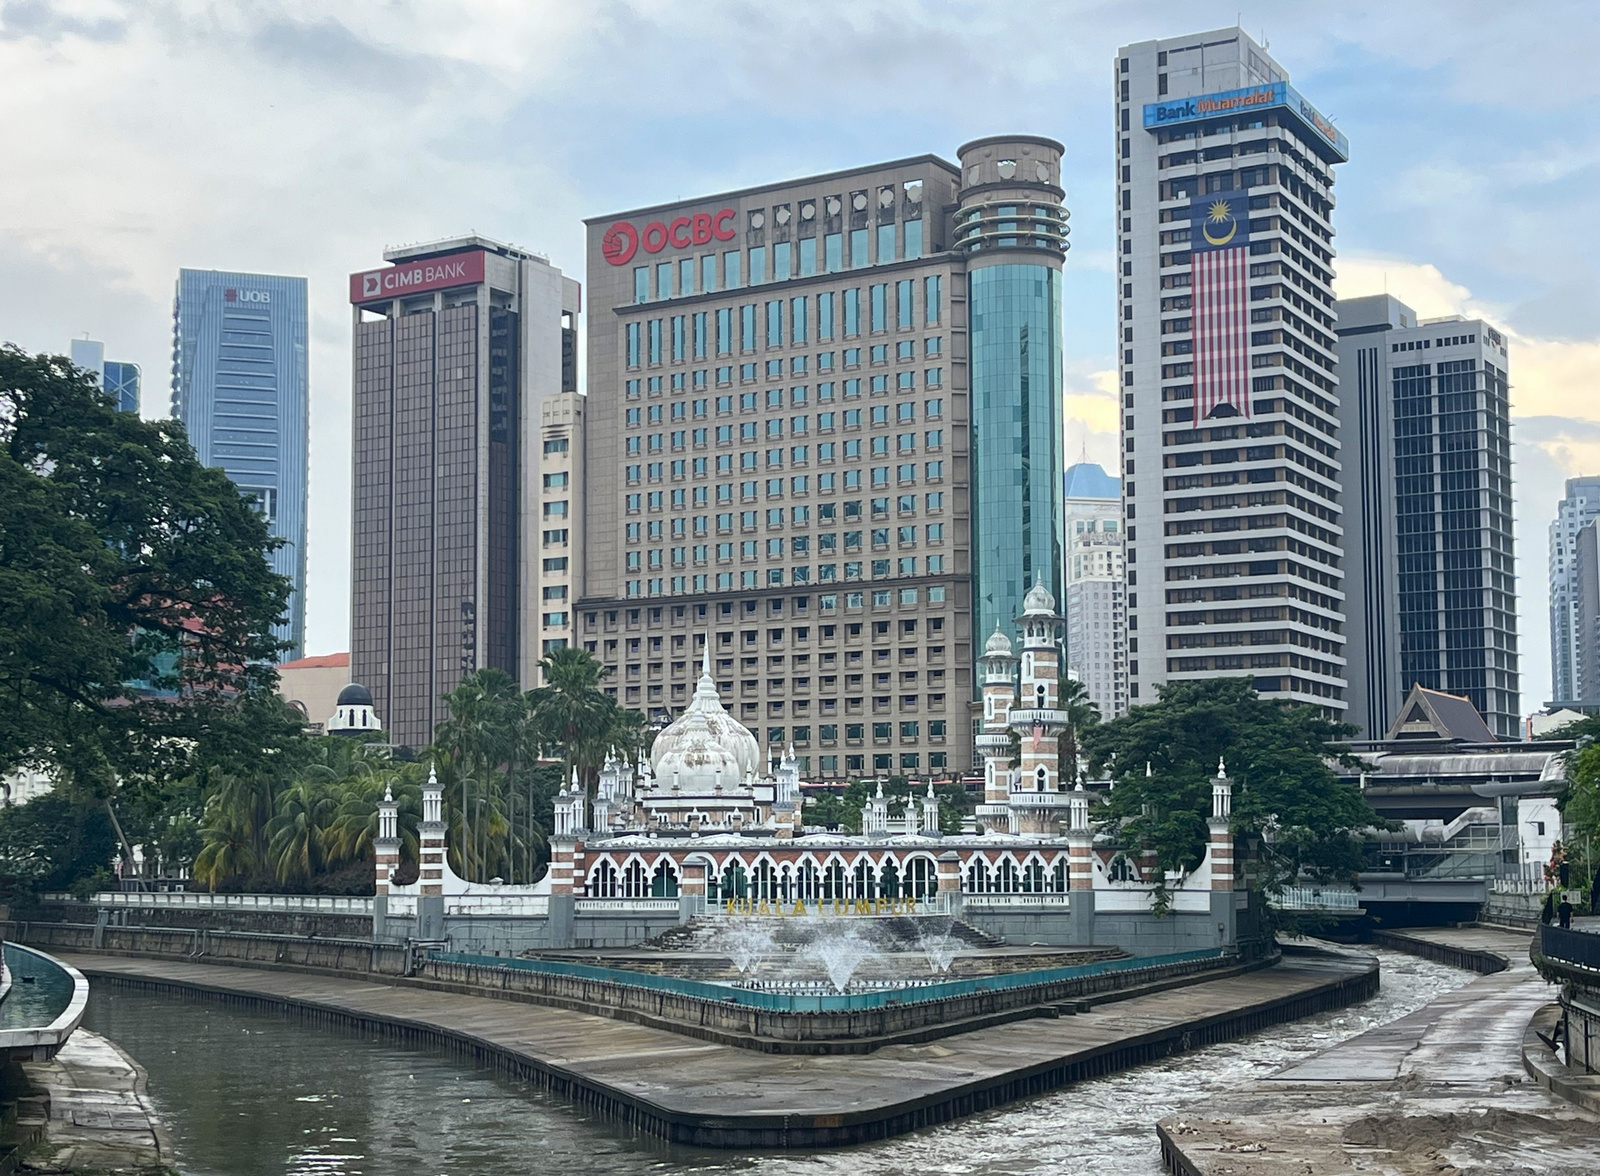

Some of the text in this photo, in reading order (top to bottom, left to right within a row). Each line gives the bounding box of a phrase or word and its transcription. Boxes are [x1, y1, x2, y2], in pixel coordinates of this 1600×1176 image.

[1156, 89, 1274, 122] Bank Muamalat
[641, 208, 737, 254] OCBC
[384, 261, 466, 290] CIMB BANK
[240, 289, 271, 304] UOB
[726, 897, 807, 917] KUALA
